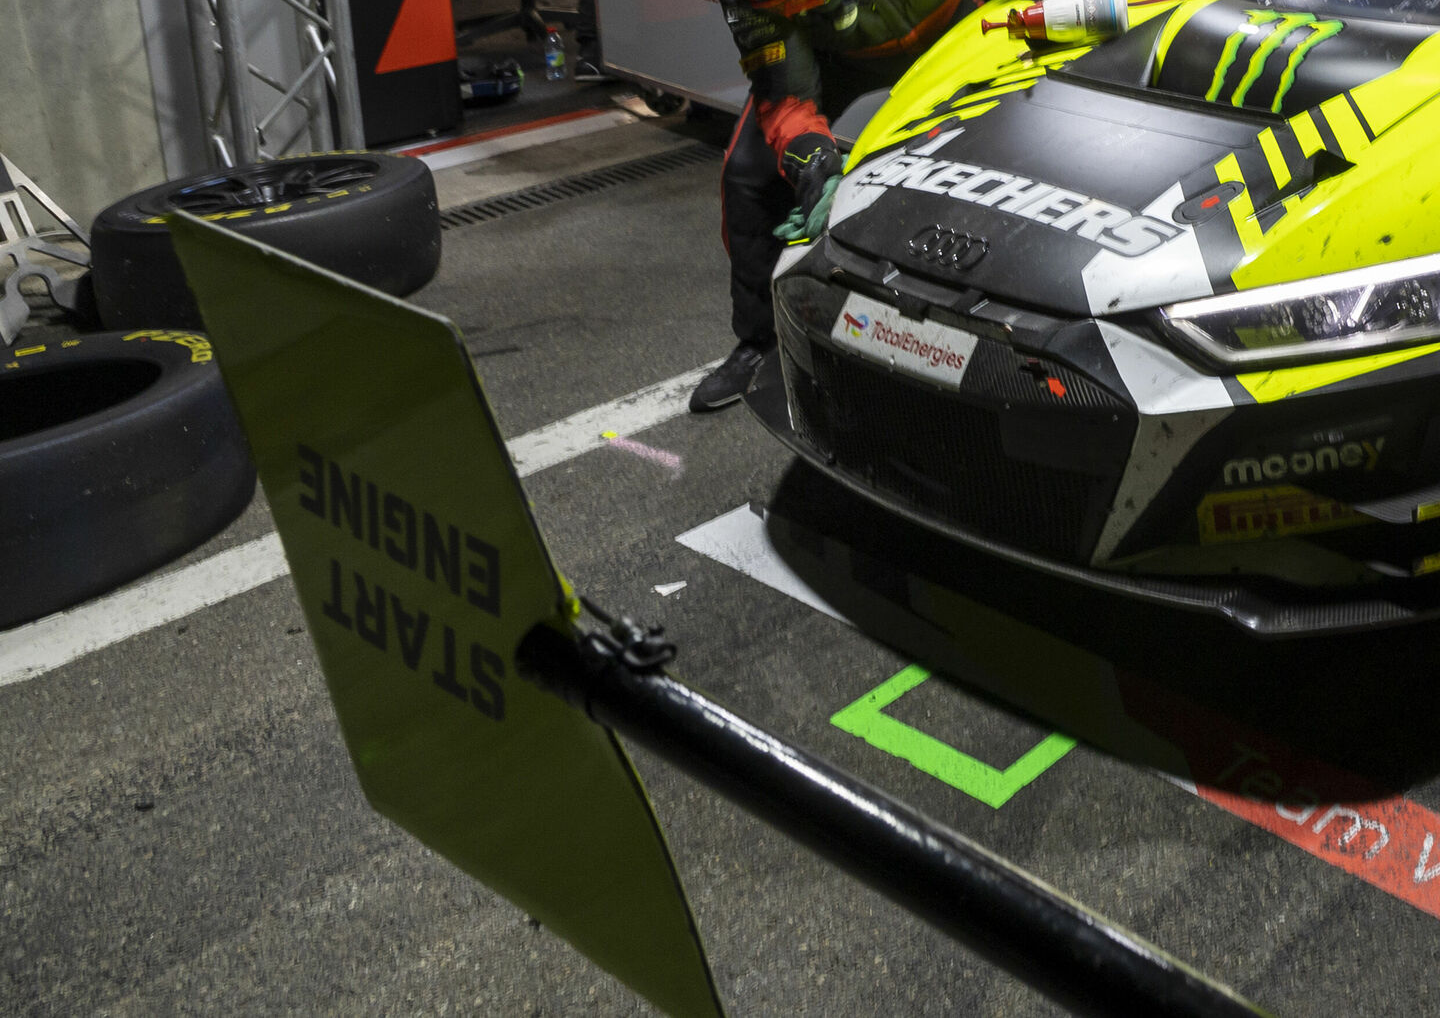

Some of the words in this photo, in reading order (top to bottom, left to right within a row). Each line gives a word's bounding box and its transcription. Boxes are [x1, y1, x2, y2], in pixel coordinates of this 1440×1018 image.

[857, 154, 1187, 258] SKECHERS
[871, 319, 967, 372] TotalEnergies
[1223, 437, 1386, 486] mooney
[298, 443, 501, 619] ENGINE
[322, 558, 507, 722] START
